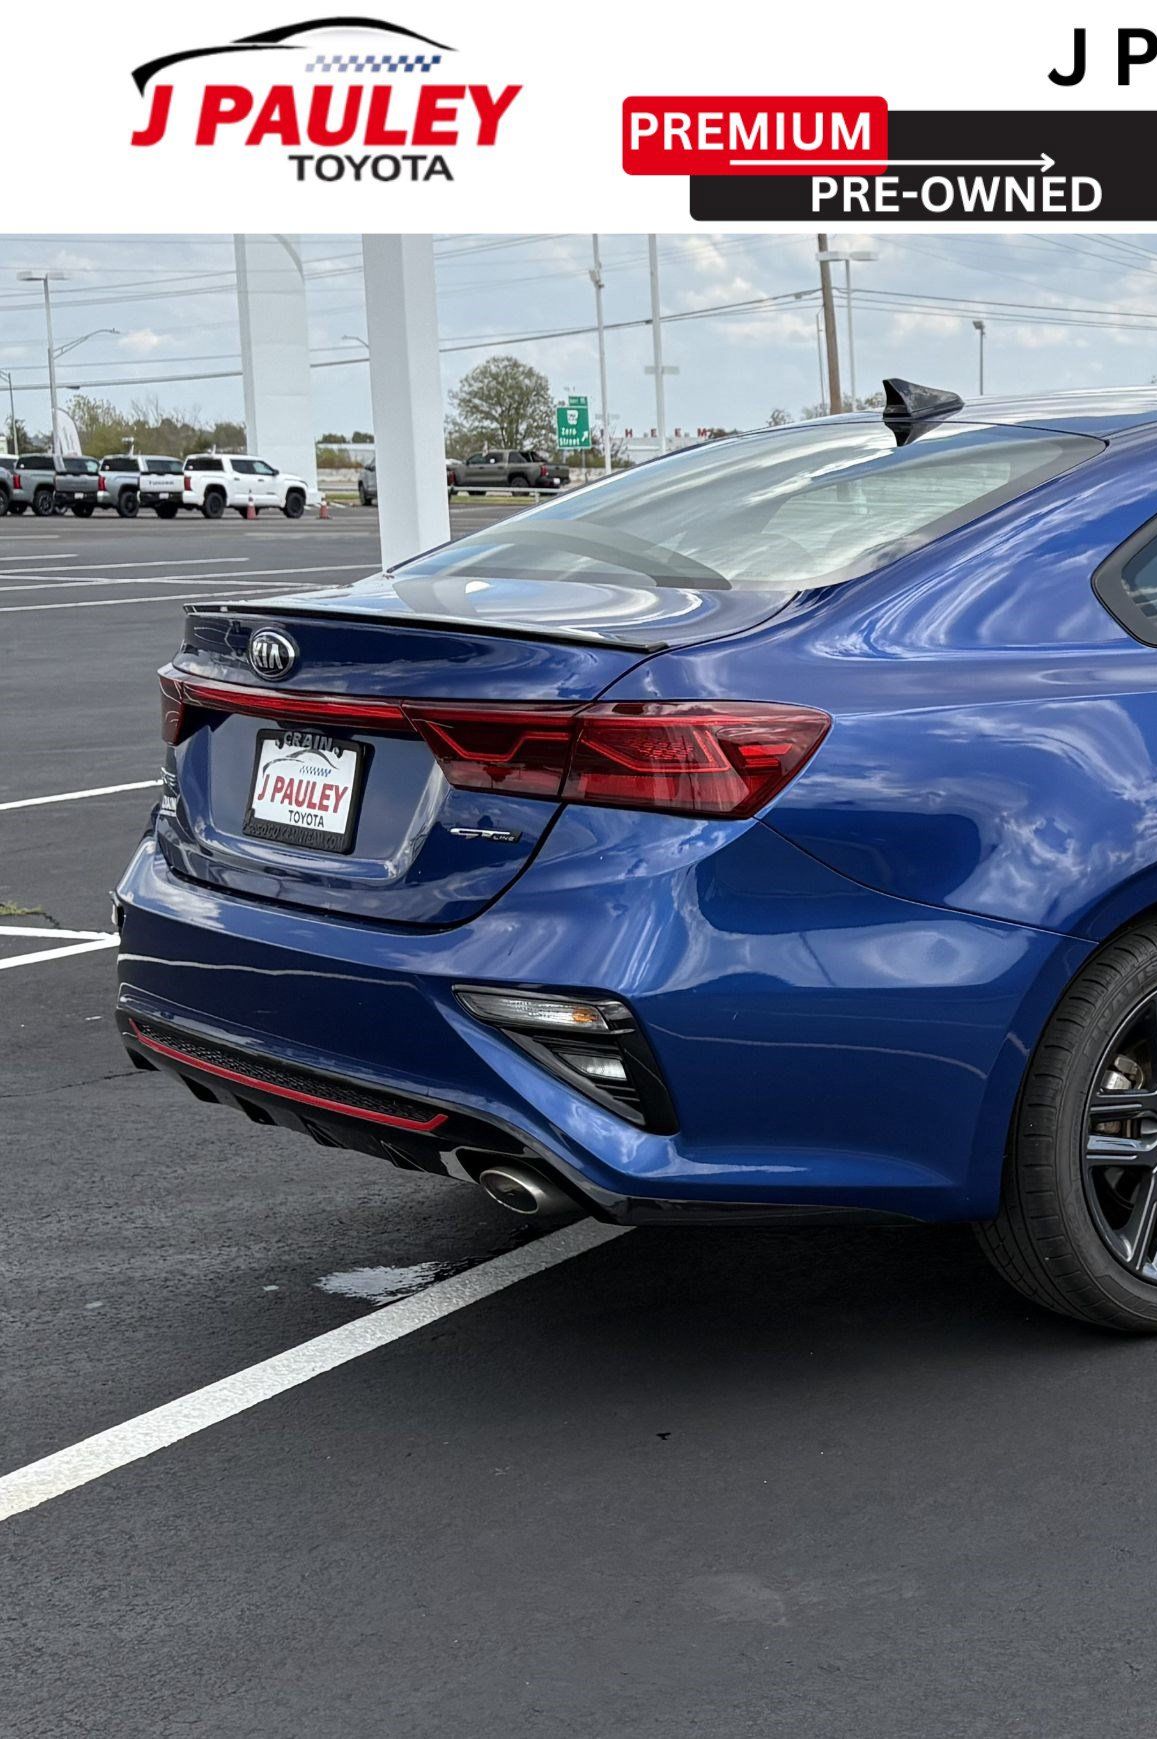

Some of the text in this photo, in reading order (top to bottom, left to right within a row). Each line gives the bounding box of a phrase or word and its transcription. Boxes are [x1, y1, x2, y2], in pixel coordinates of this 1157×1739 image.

[559, 437, 580, 446] Street
[252, 640, 284, 670] KIA
[283, 731, 333, 752] CRAIN
[257, 773, 349, 814] J PAULEY
[288, 809, 325, 828] TOYOTA
